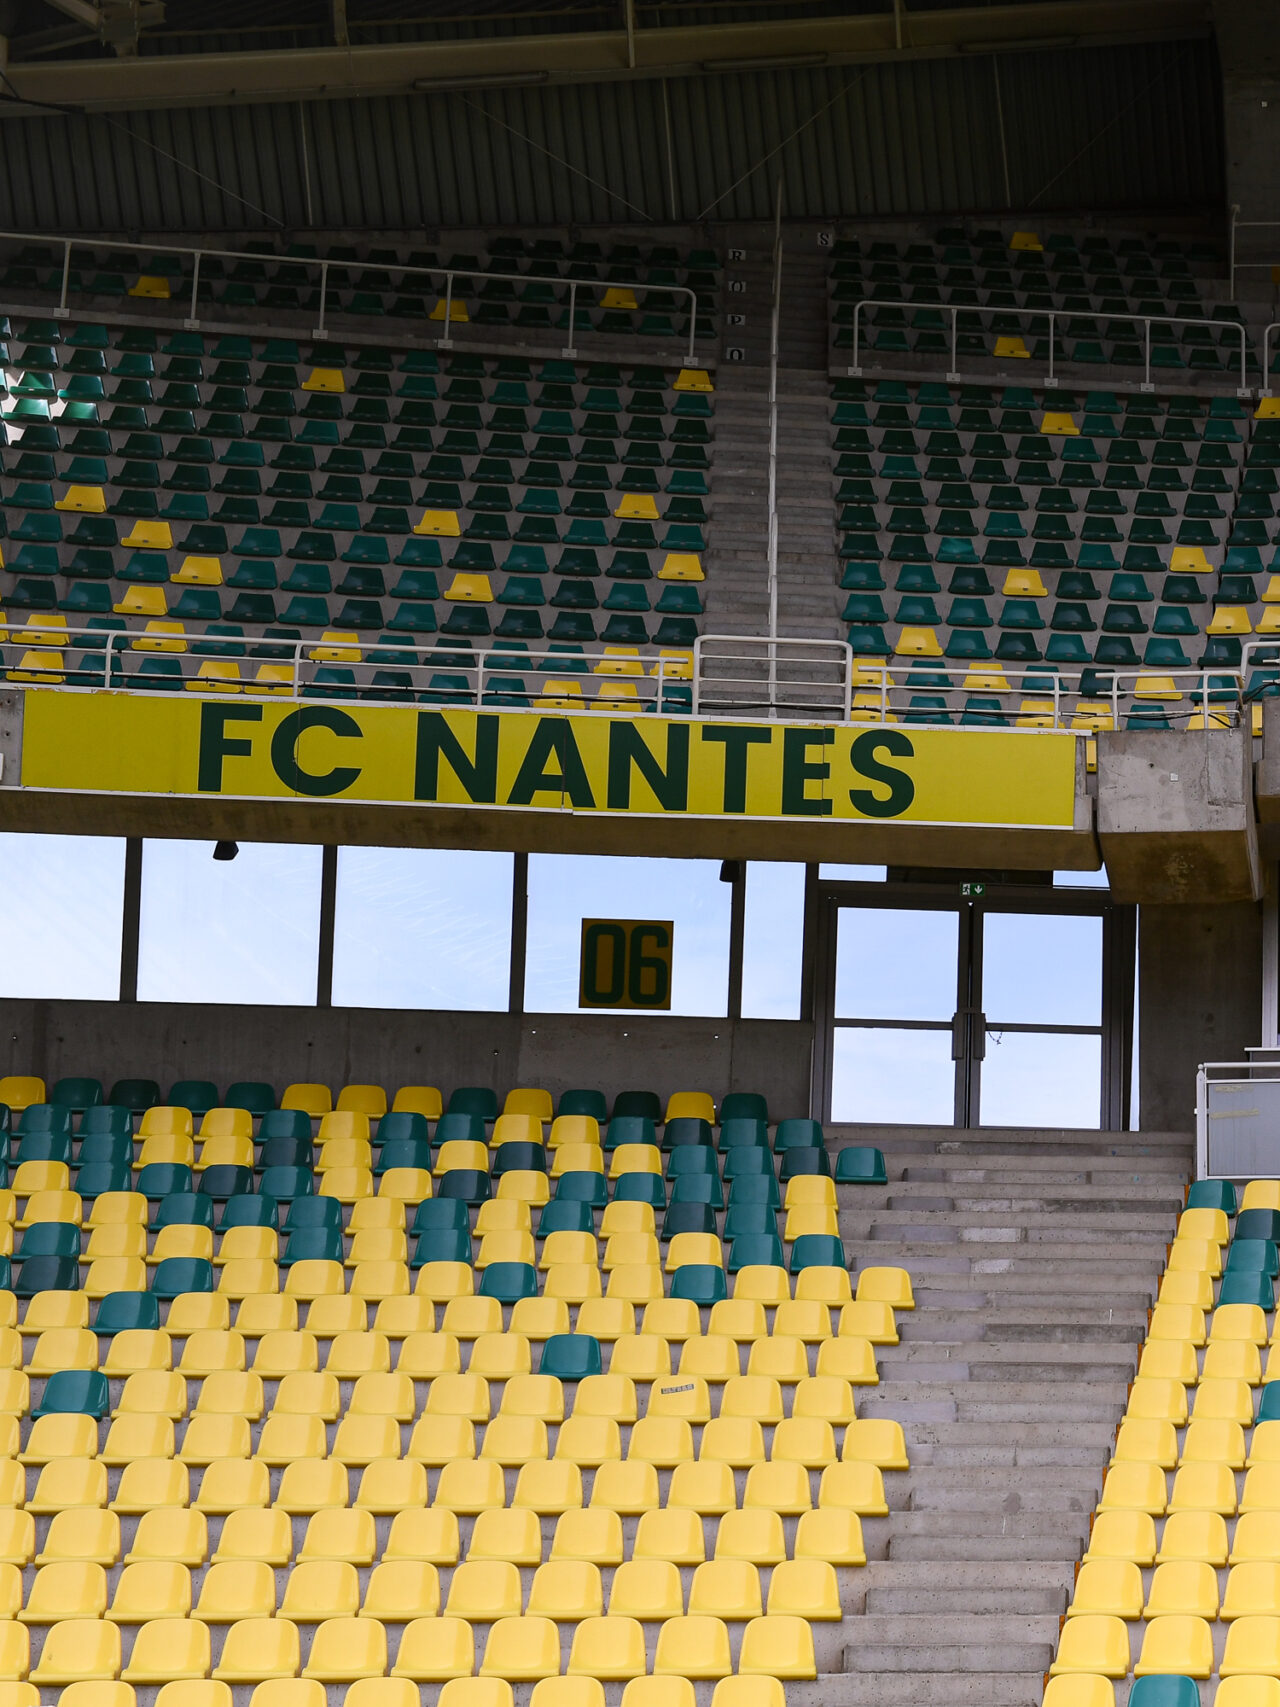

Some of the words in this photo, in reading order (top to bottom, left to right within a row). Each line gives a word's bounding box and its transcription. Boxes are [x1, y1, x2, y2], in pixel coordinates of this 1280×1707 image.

[732, 250, 742, 261] R
[820, 232, 829, 246] S
[198, 702, 364, 797] FC
[414, 711, 916, 819] NANTES
[583, 924, 669, 1005] 06
